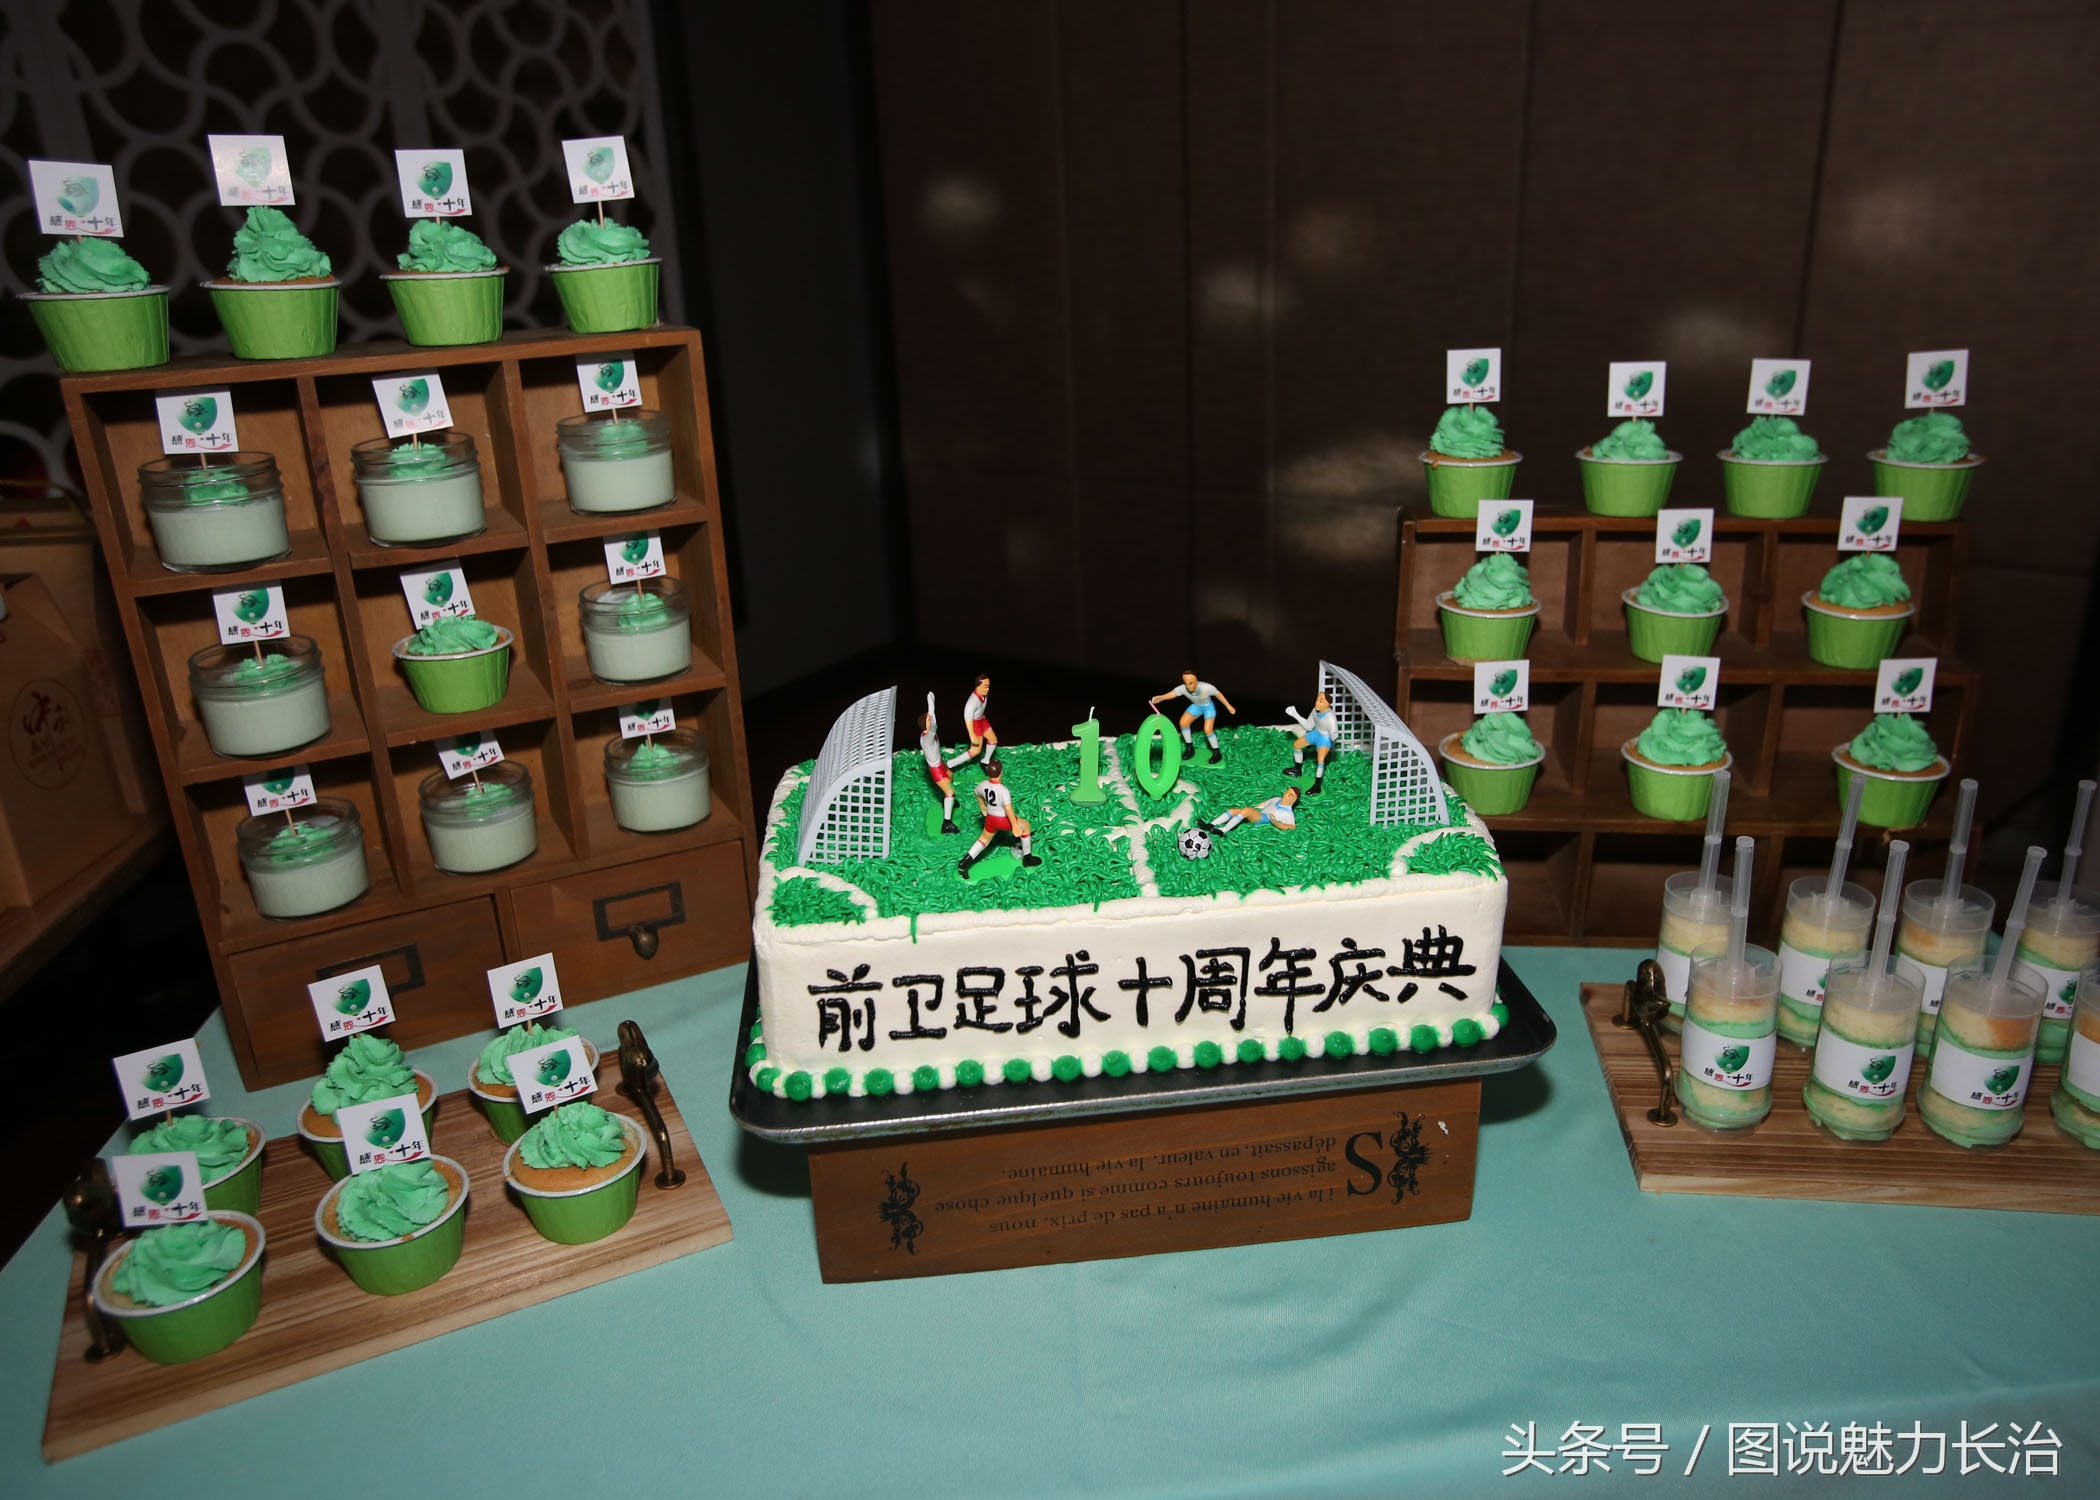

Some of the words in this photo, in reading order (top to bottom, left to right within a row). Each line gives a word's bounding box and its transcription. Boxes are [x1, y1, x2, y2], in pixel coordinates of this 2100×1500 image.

[984, 788, 997, 807] 12
[807, 924, 1476, 1052] 前卫足球十周年庆典
[1219, 1146, 1241, 1159] en
[1001, 1162, 1090, 1182] humaine.
[1095, 1159, 1124, 1175] vie
[1128, 1156, 1145, 1172] la
[1259, 1155, 1337, 1180] agissons
[1099, 1179, 1169, 1197] comme
[1173, 1169, 1255, 1189] toujours
[996, 1186, 1074, 1208] quelque
[1080, 1187, 1096, 1202] si
[1276, 1191, 1304, 1206] vie
[1308, 1189, 1323, 1203] la
[934, 1196, 990, 1214] chose
[1119, 1203, 1151, 1221] pas
[1190, 1194, 1271, 1214] humaine
[989, 1218, 1036, 1234] nous
[1093, 1210, 1116, 1226] de
